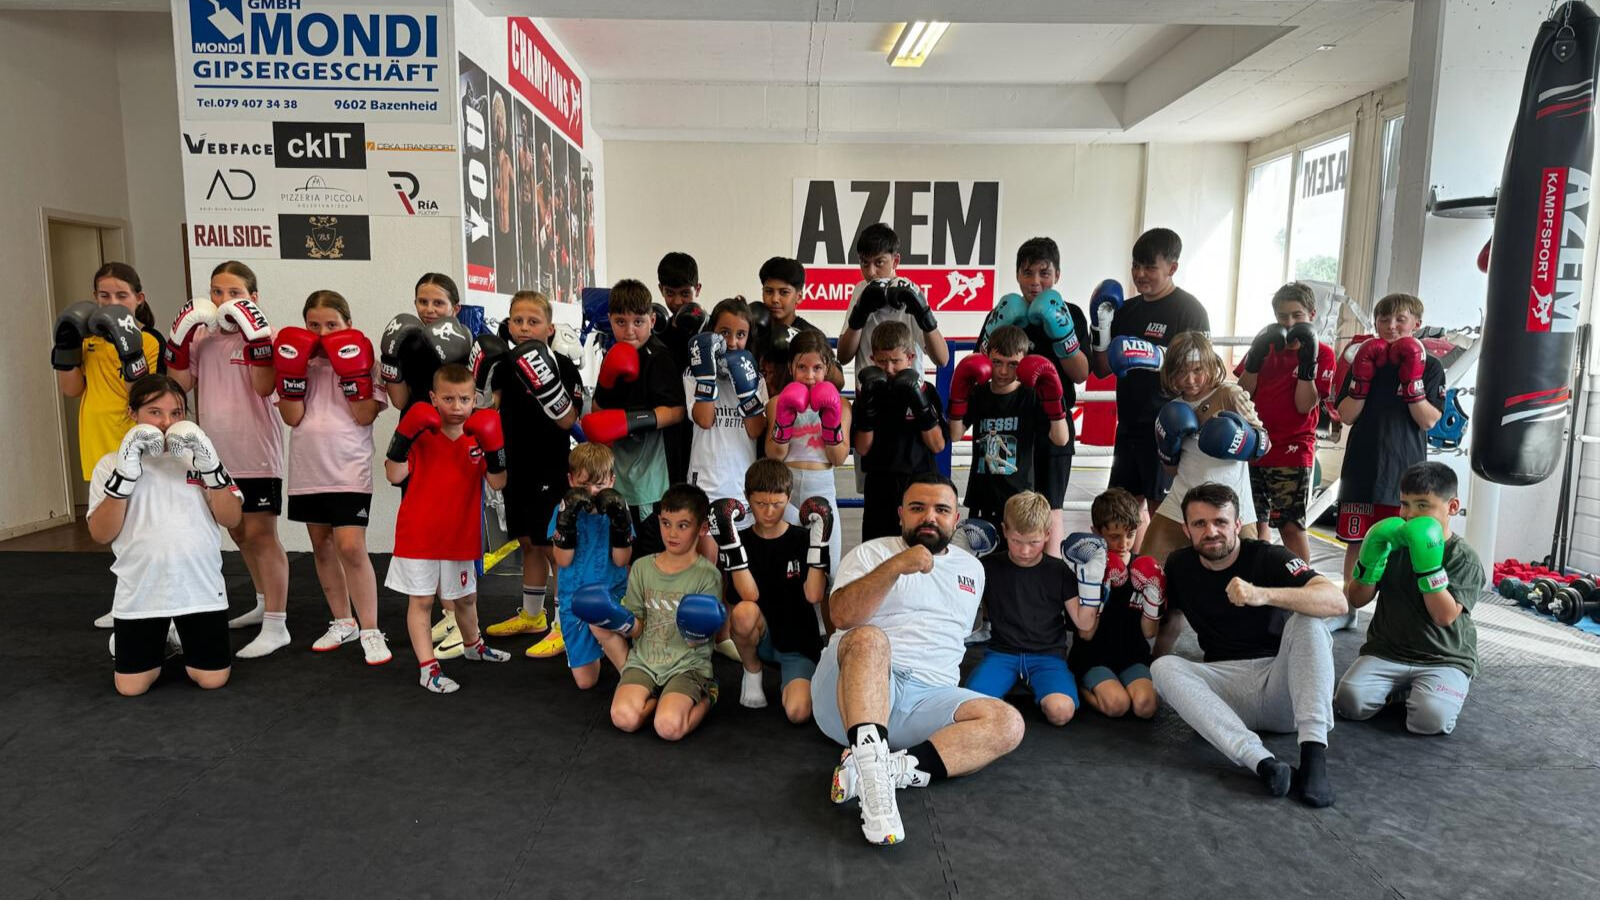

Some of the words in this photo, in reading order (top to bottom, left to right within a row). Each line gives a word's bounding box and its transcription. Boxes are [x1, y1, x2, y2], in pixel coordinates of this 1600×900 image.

[250, 12, 438, 57] MONDI
[195, 42, 243, 53] MONDI
[193, 60, 438, 82] GIPSERGESCHÄFT
[511, 20, 570, 119] CHAMPIONS
[241, 99, 263, 109] 407
[266, 100, 280, 109] 34
[283, 100, 298, 109] 38
[334, 99, 367, 110] 9602
[370, 100, 437, 112] Bazenheid
[287, 132, 351, 159] ckIT
[465, 104, 490, 243] YOU
[280, 193, 321, 202] PIZZERIA
[324, 194, 364, 203] PICCOLA
[796, 180, 999, 266] AZEM
[1537, 173, 1559, 281] KAMPFSPORT
[194, 224, 273, 248] RAILSIDE
[1551, 167, 1592, 333] AZEM
[239, 299, 269, 329] AZEM
[1145, 322, 1167, 335] AZEM
[253, 345, 272, 357] AZEM
[1122, 340, 1154, 353] AZEM
[522, 349, 555, 386] AZEM
[283, 379, 306, 390] TWINS
[1227, 427, 1245, 455] AZEM
[1348, 515, 1361, 536] 8
